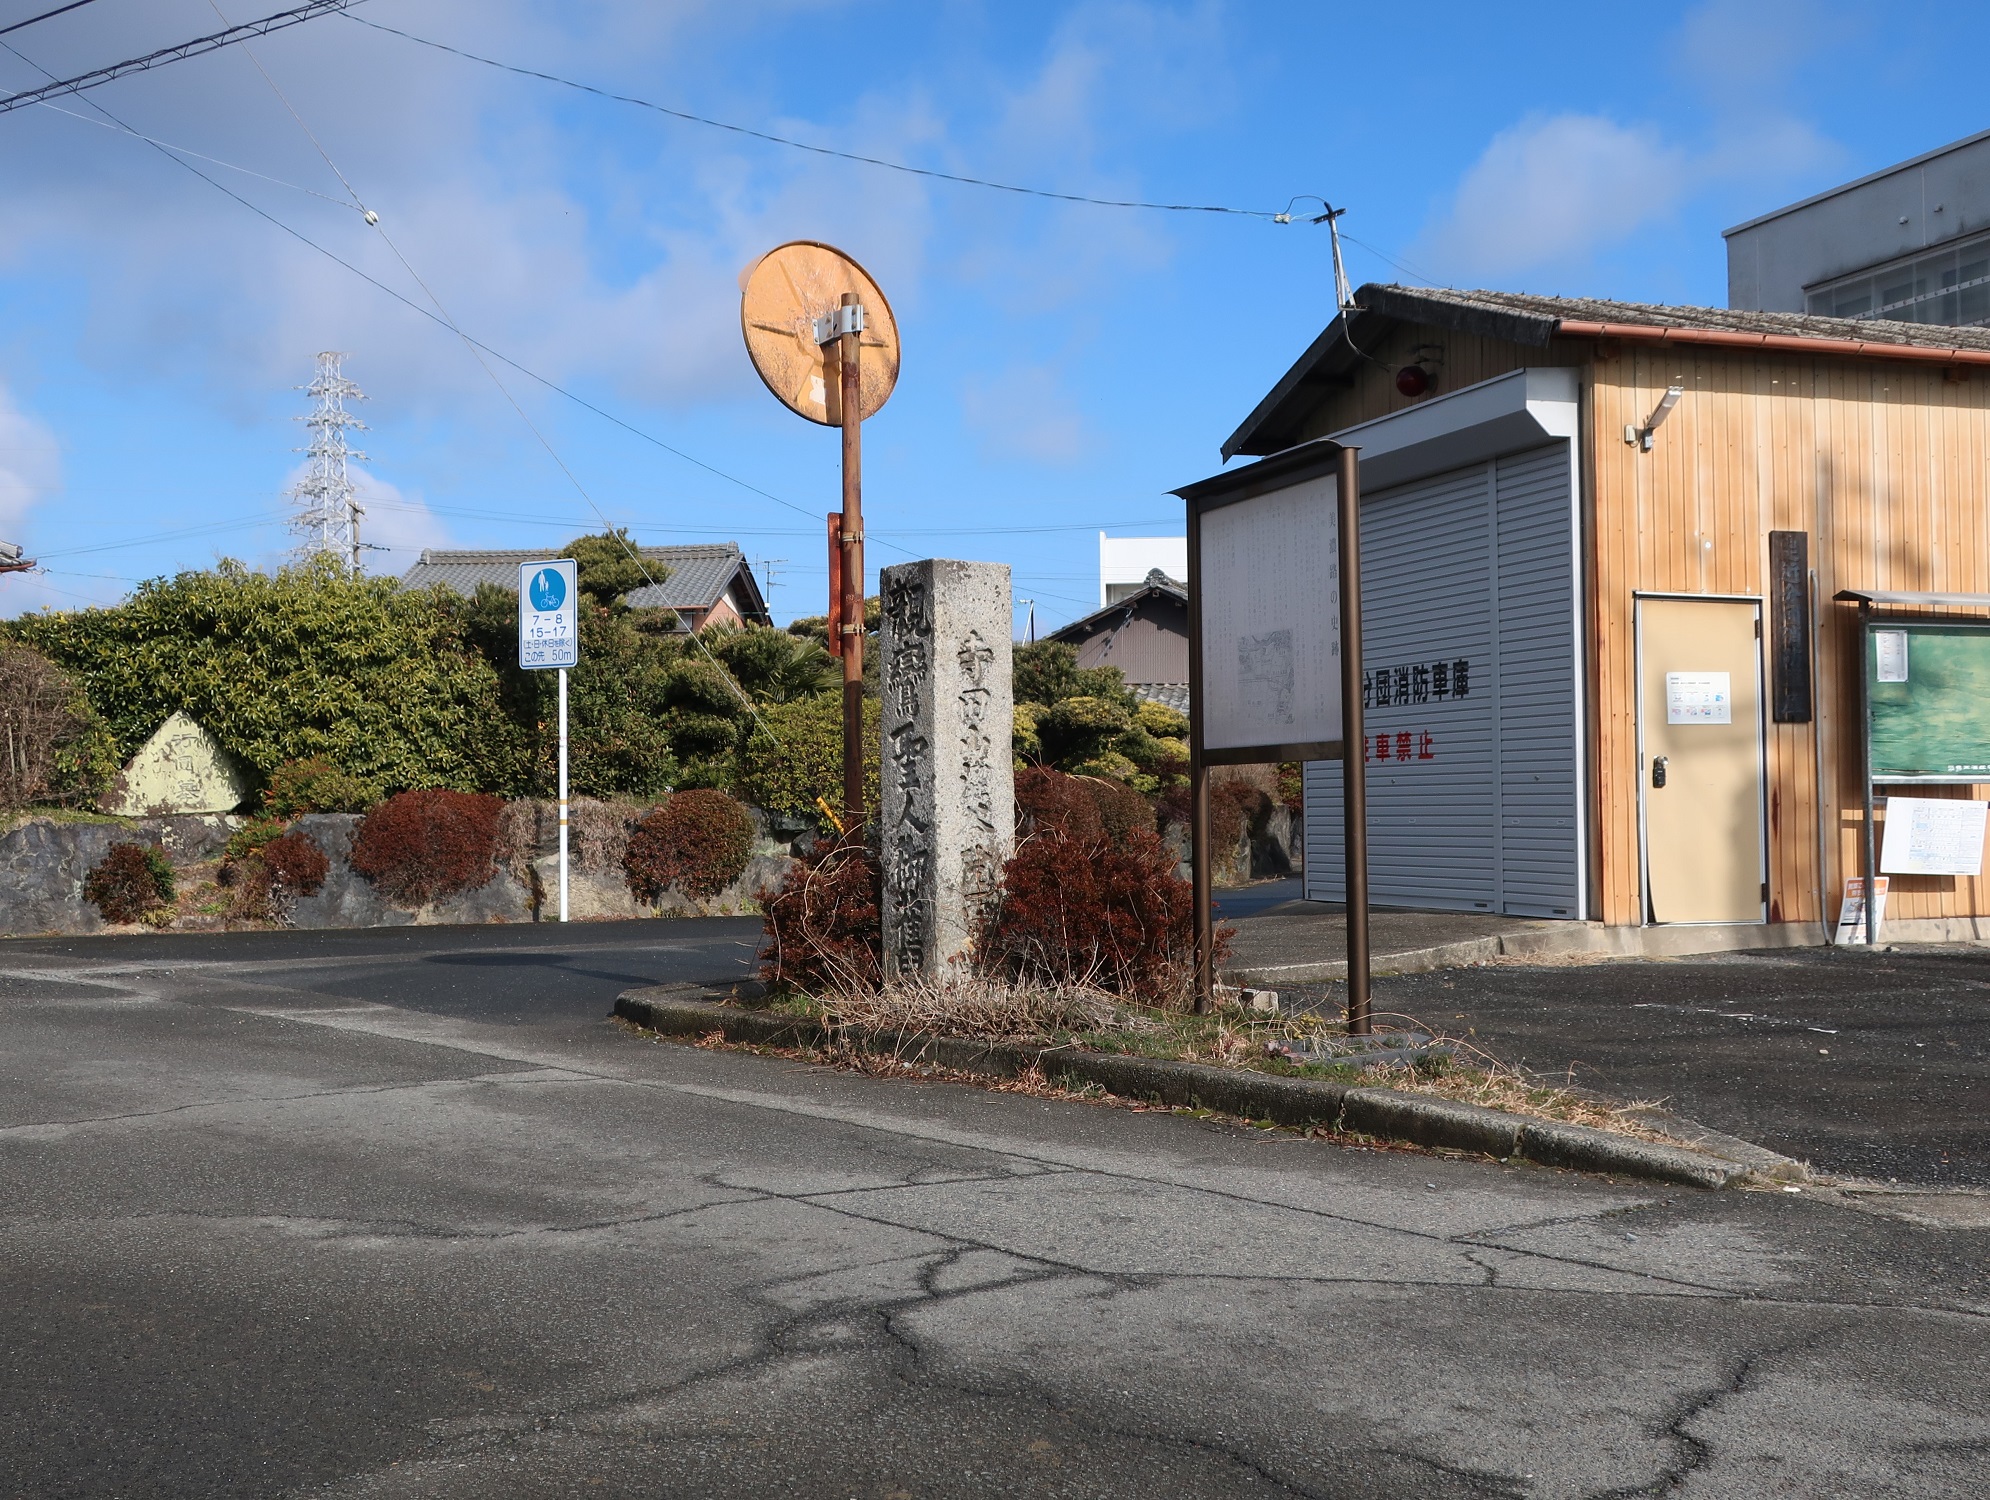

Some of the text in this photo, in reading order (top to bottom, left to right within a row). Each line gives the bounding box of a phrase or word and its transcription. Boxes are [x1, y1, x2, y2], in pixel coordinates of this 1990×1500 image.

[530, 626, 567, 638] 15-17
[525, 648, 572, 663] この先 50m
